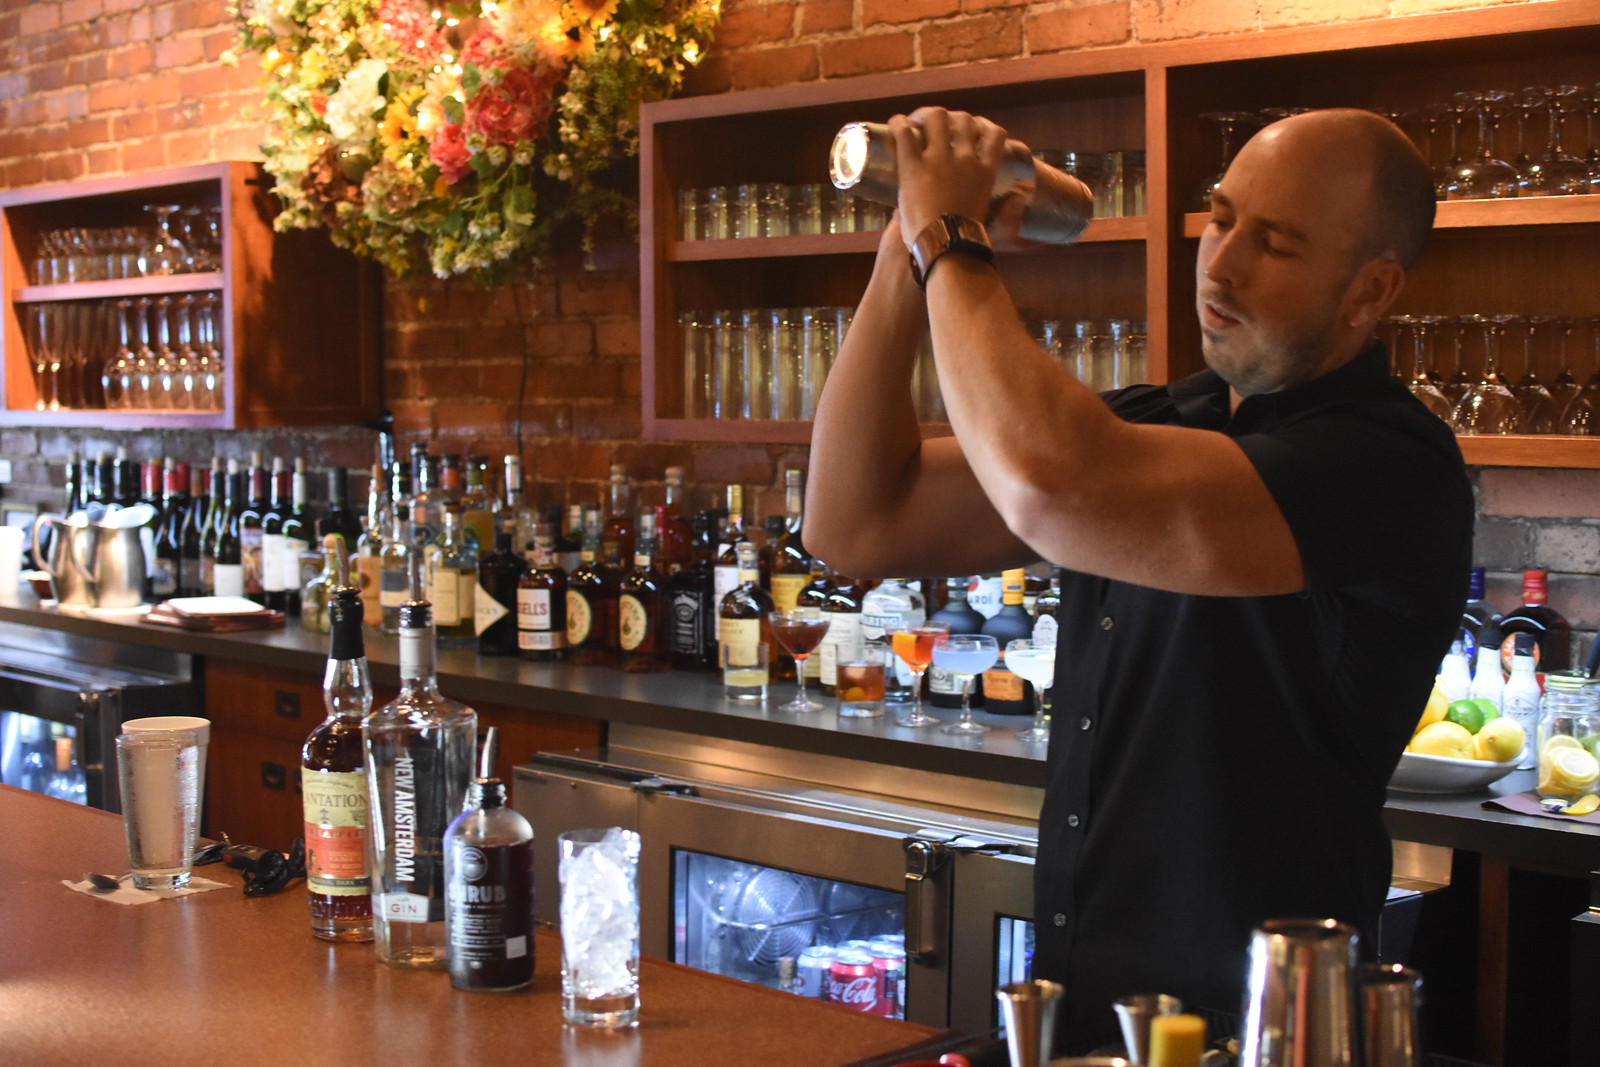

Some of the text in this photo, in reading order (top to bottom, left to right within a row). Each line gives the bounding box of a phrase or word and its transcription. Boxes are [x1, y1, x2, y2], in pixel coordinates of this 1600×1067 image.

[395, 757, 415, 791] NEW
[395, 790, 415, 882] AMSTERDAM
[449, 885, 507, 903] HRUB
[391, 903, 418, 913] GIN
